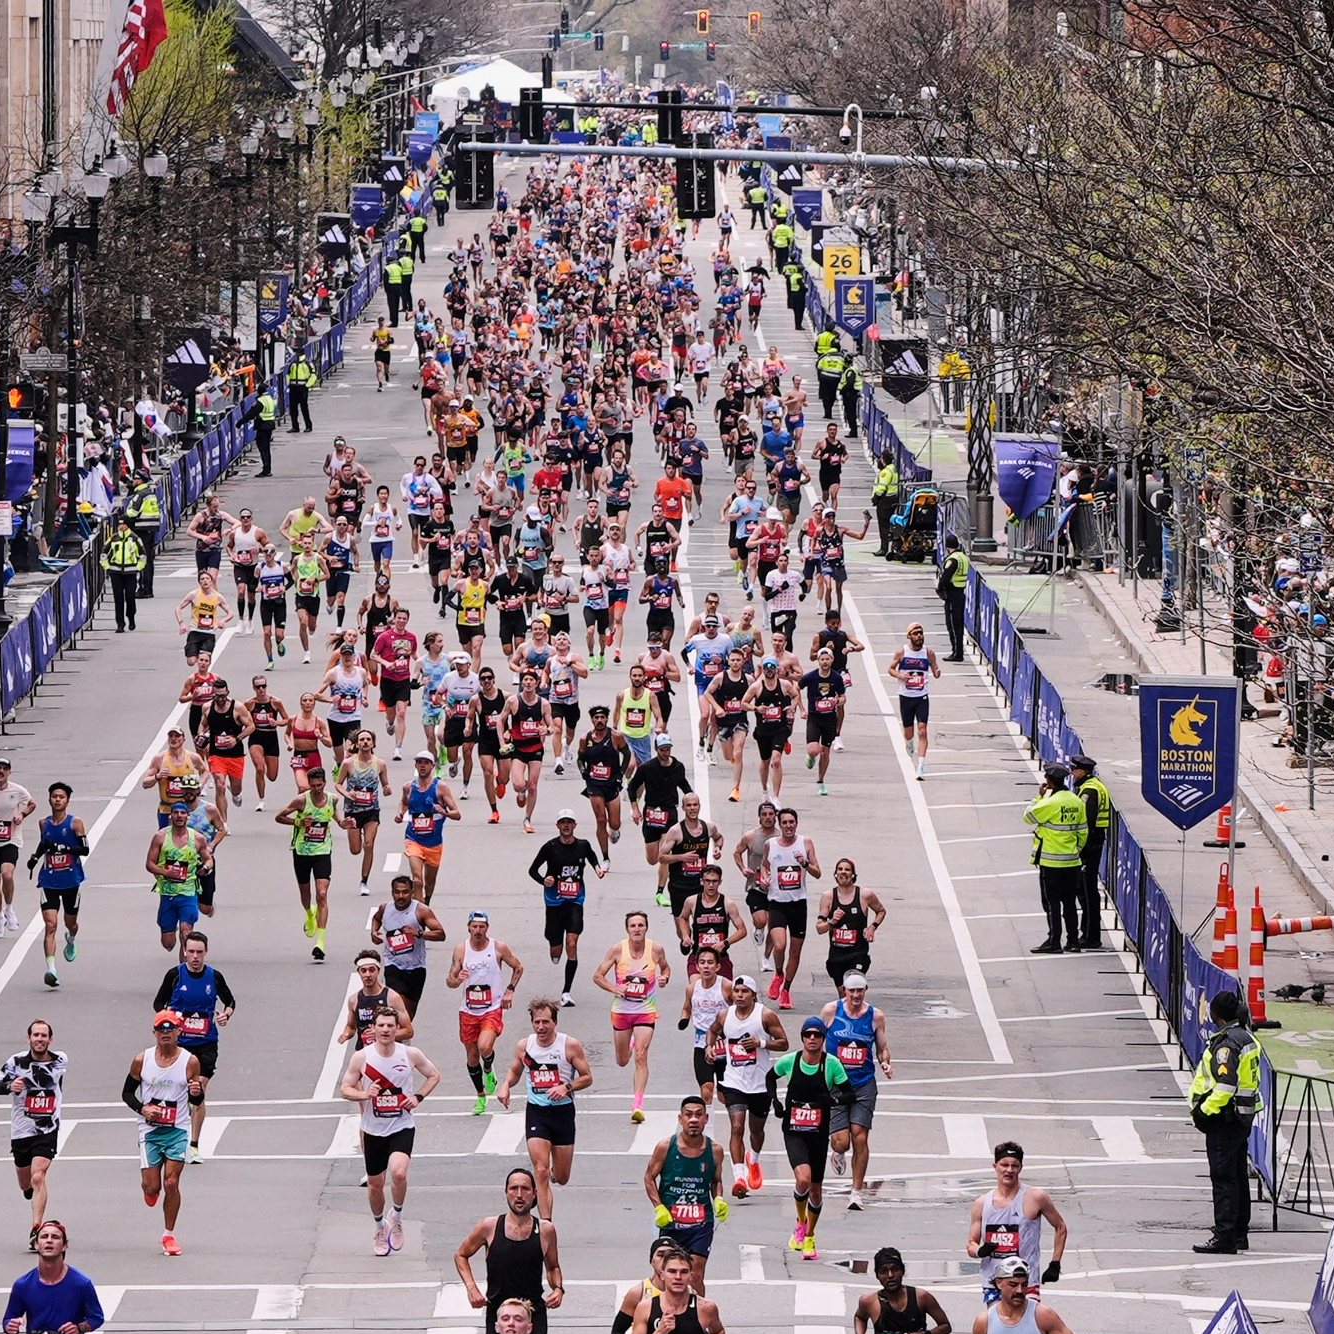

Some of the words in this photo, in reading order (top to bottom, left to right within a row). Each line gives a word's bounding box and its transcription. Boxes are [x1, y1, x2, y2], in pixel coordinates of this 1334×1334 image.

[829, 253, 853, 269] 26
[1161, 750, 1213, 762] BOSTON
[1161, 763, 1213, 772] MARATHON
[31, 1097, 50, 1108] 1341
[676, 1205, 700, 1218] 7718
